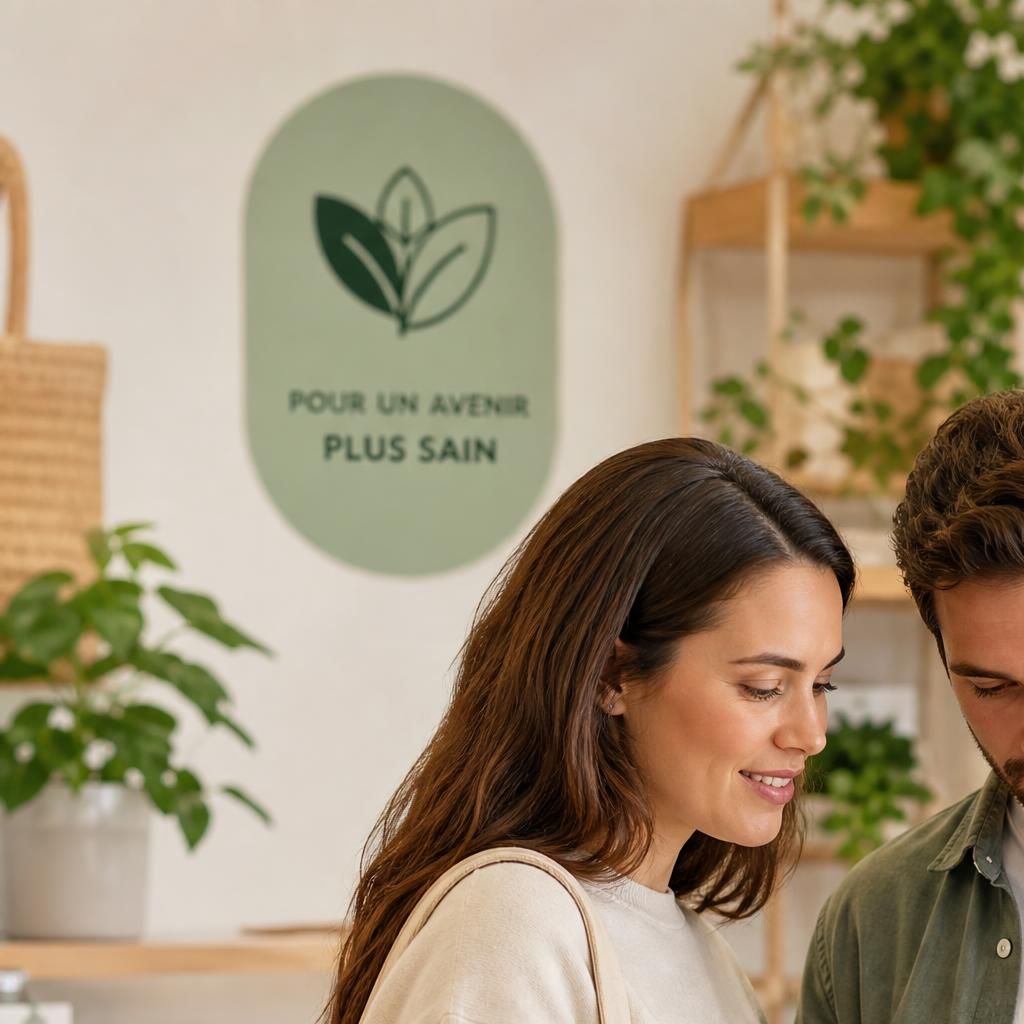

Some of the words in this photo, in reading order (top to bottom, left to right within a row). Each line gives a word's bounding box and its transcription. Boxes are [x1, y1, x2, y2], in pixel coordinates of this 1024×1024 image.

[288, 389, 366, 414] POUR
[377, 391, 419, 416] UN
[430, 393, 529, 418] AVENIR
[323, 434, 406, 463] PLUS
[419, 436, 497, 463] SAIN
